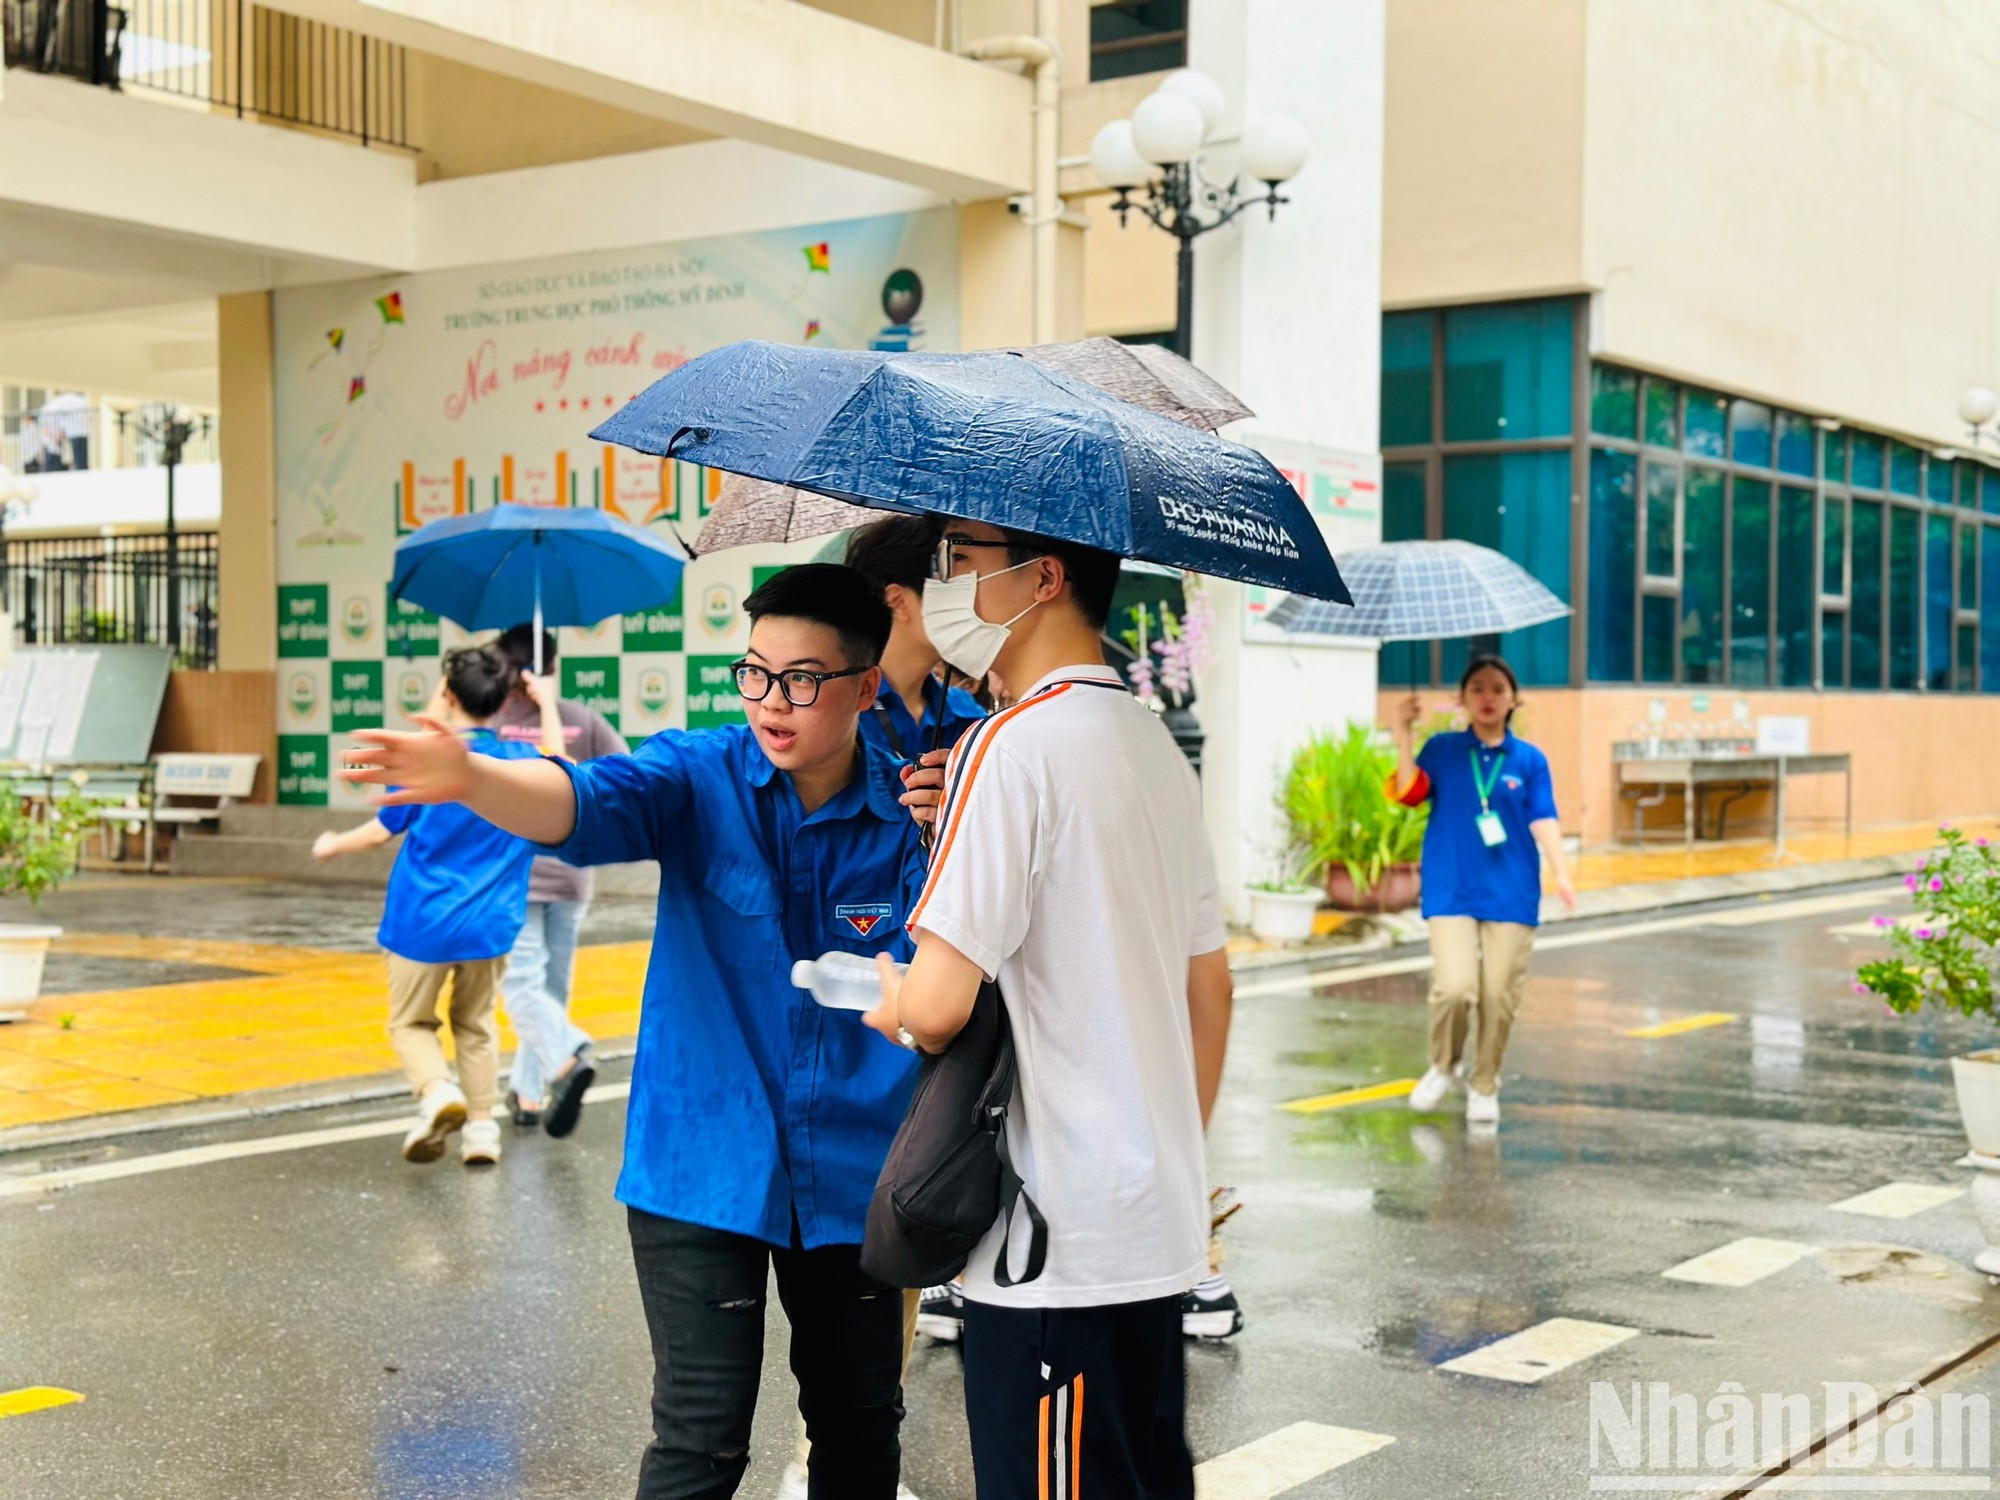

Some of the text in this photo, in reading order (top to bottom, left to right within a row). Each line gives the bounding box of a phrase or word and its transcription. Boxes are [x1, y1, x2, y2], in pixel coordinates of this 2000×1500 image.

[290, 599, 316, 616] THPT
[343, 674, 370, 690] THPT
[575, 670, 605, 687] THPT
[701, 666, 731, 684] THPT
[290, 752, 316, 768] THPT
